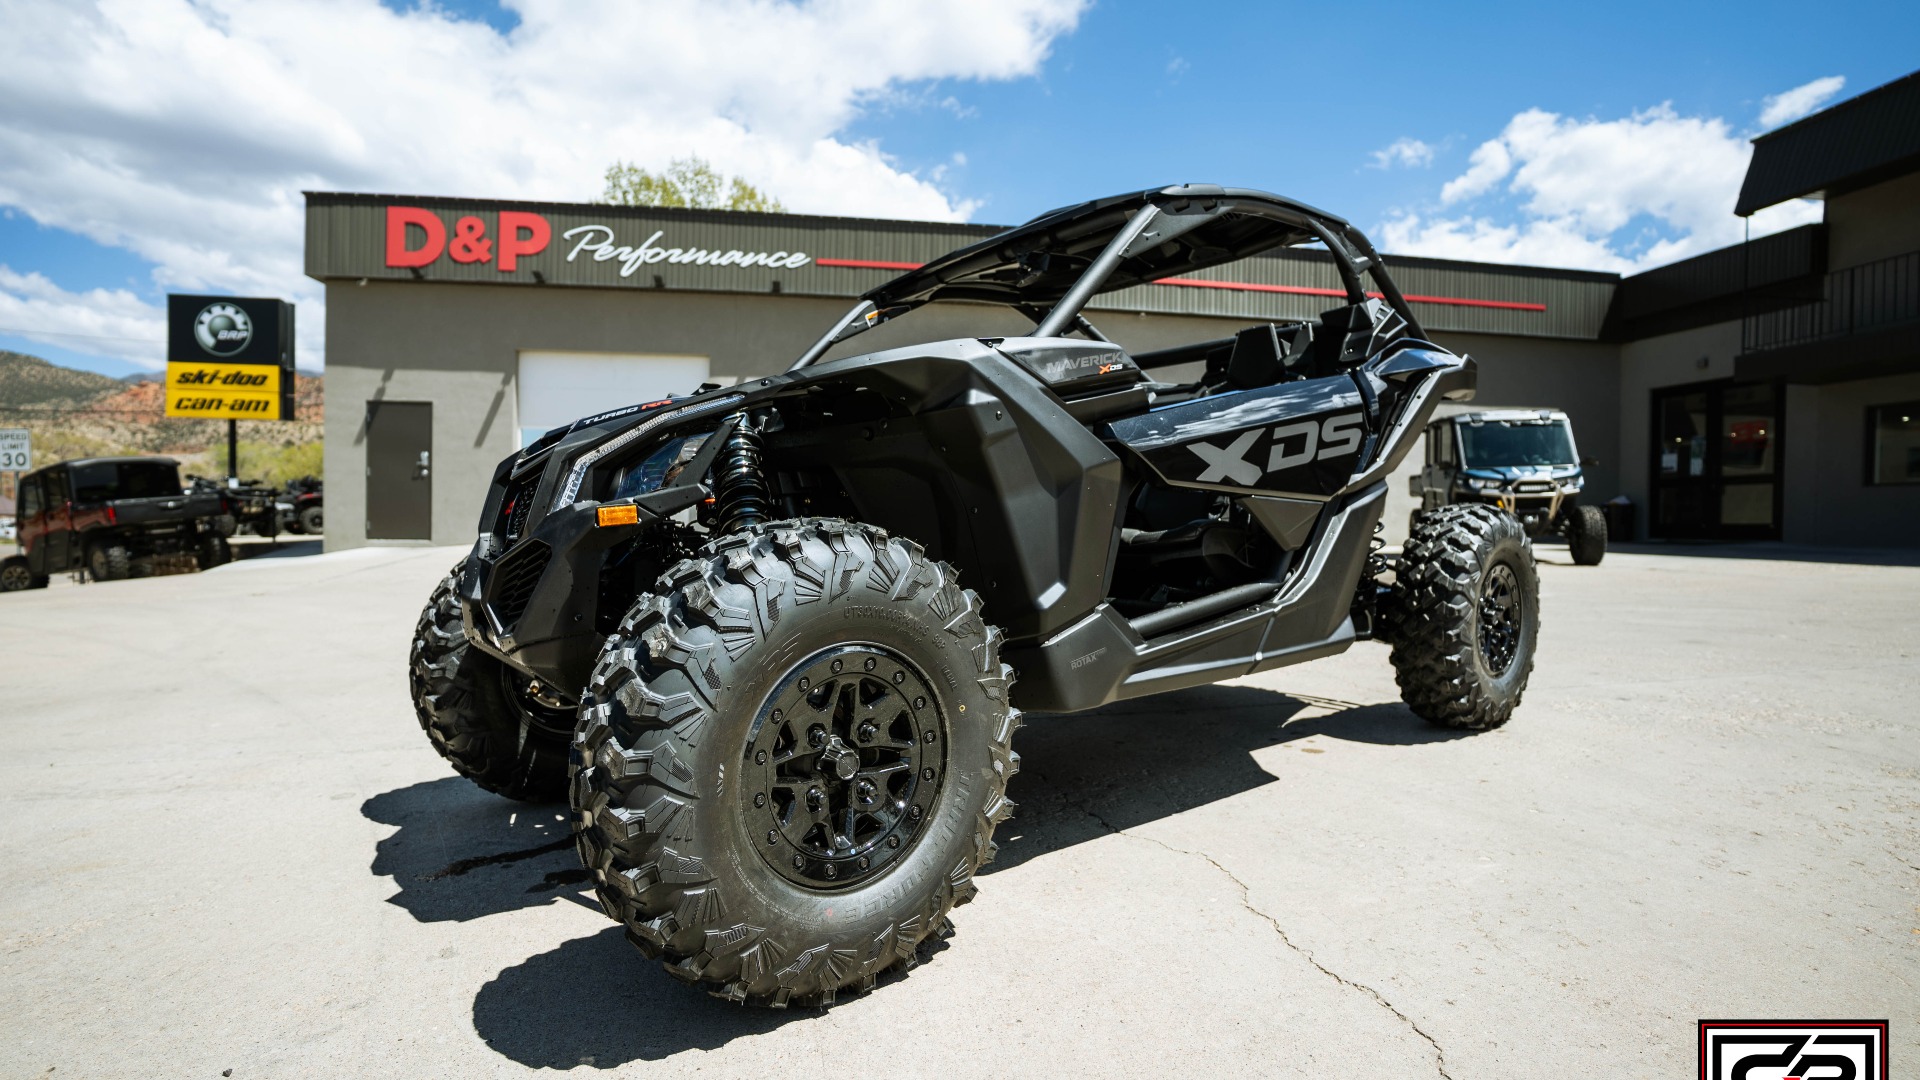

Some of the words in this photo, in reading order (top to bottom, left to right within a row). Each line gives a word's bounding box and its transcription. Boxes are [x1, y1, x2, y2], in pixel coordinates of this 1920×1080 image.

[385, 205, 551, 272] D&P
[562, 224, 812, 278] Performance
[1046, 351, 1123, 374] MAVERICK
[1098, 363, 1123, 375] XDS
[176, 368, 269, 387] ski-doo
[174, 395, 272, 413] can-am
[583, 406, 639, 425] TURBO
[641, 399, 673, 411] RR
[0, 432, 27, 441] SPEED
[1, 442, 25, 451] LIMIT
[1186, 412, 1364, 486] XDS
[2, 452, 27, 467] 30
[1070, 654, 1097, 670] ROTAX
